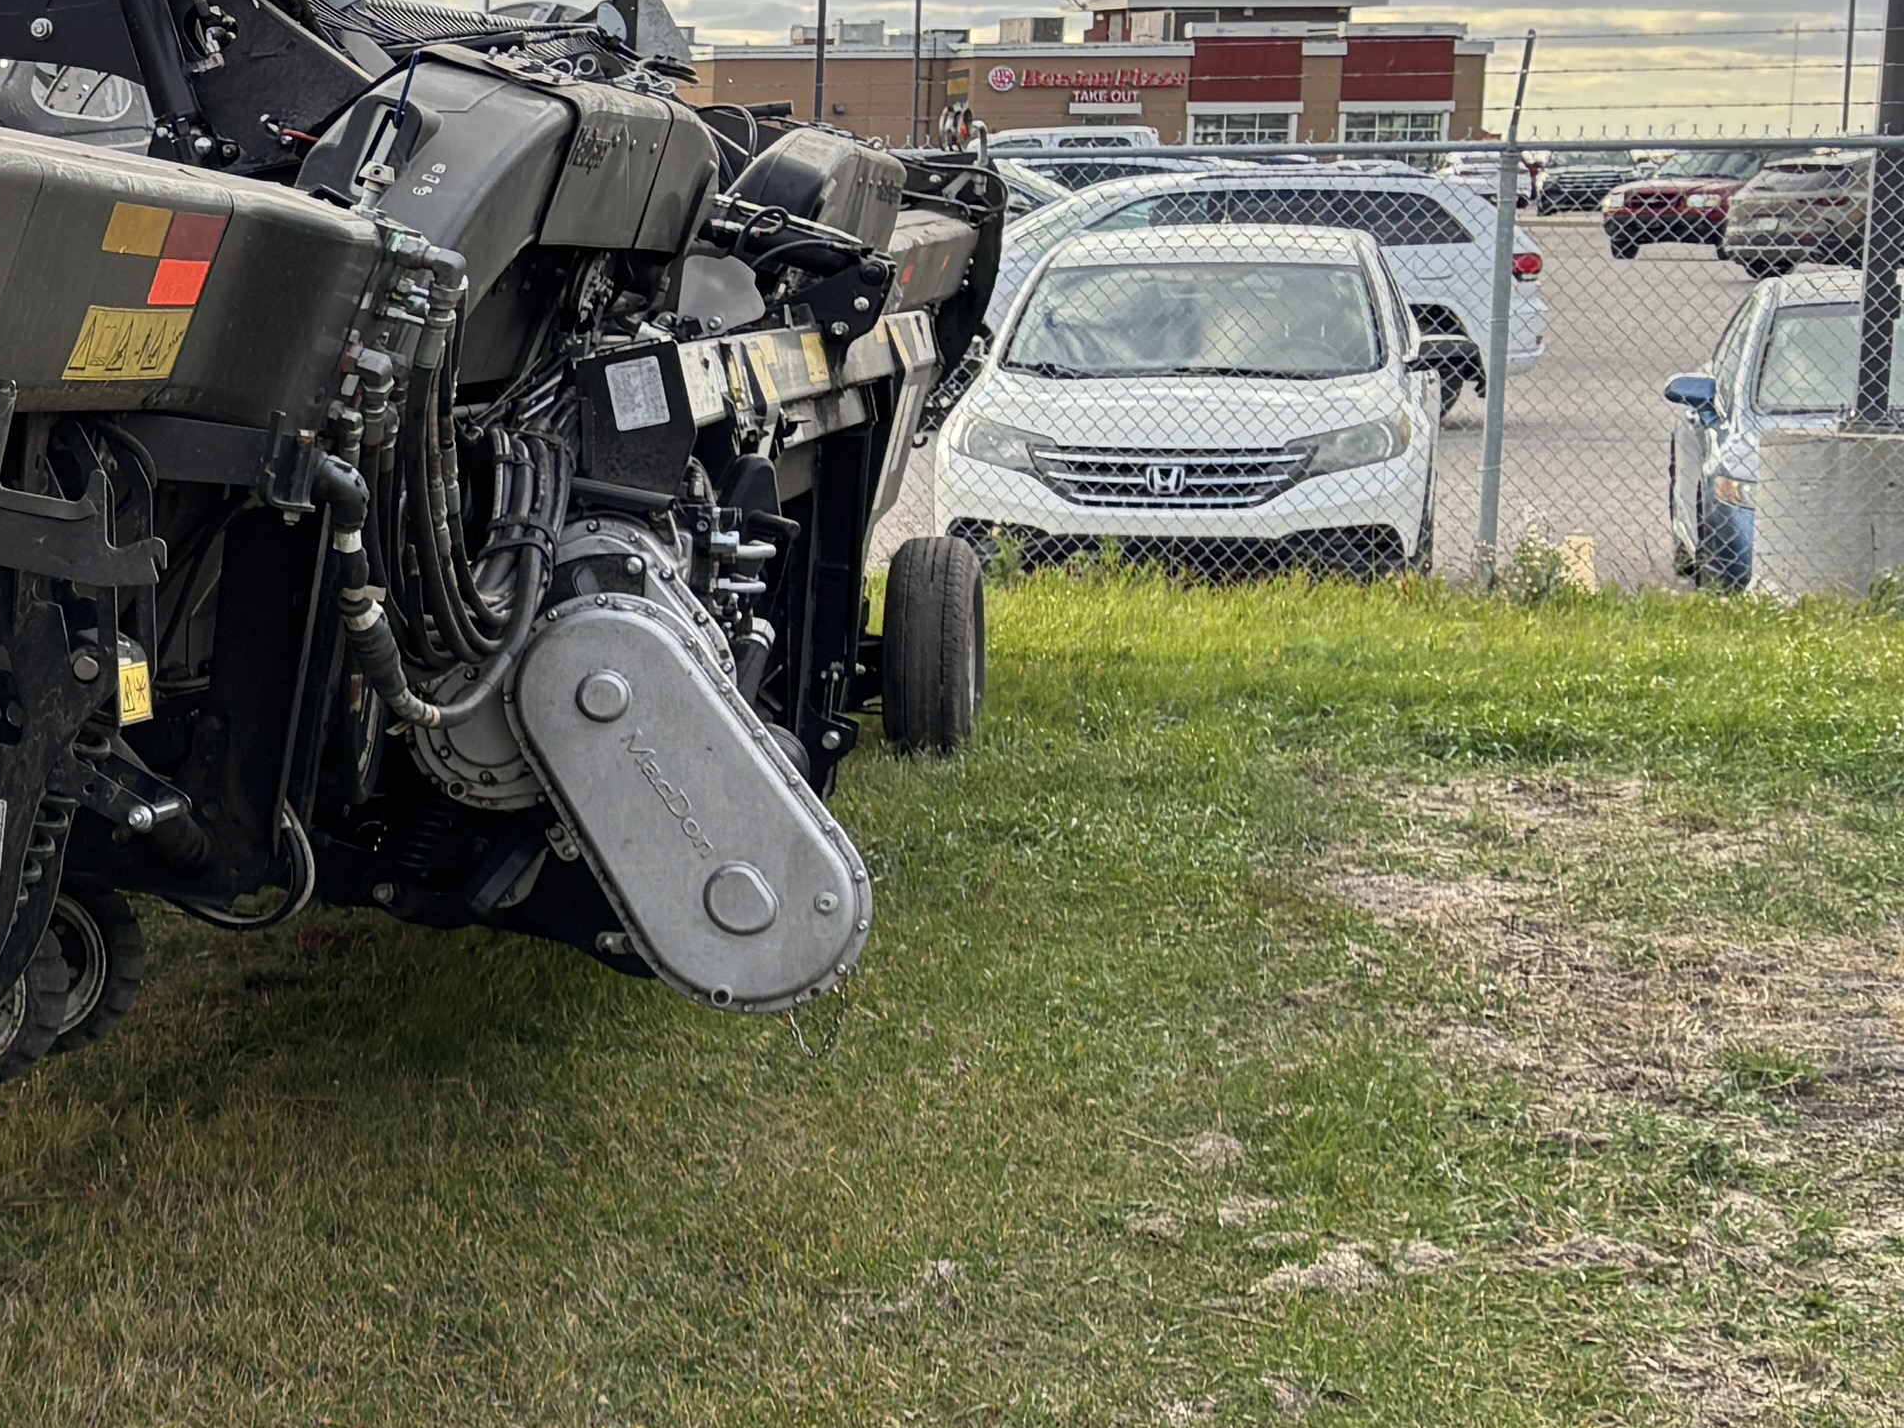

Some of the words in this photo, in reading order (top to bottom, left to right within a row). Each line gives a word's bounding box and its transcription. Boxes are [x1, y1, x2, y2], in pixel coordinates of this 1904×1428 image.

[1114, 68, 1188, 88] Pizza
[1072, 90, 1107, 103] TAKE
[1110, 90, 1140, 103] OUT
[620, 725, 715, 860] MacDon
